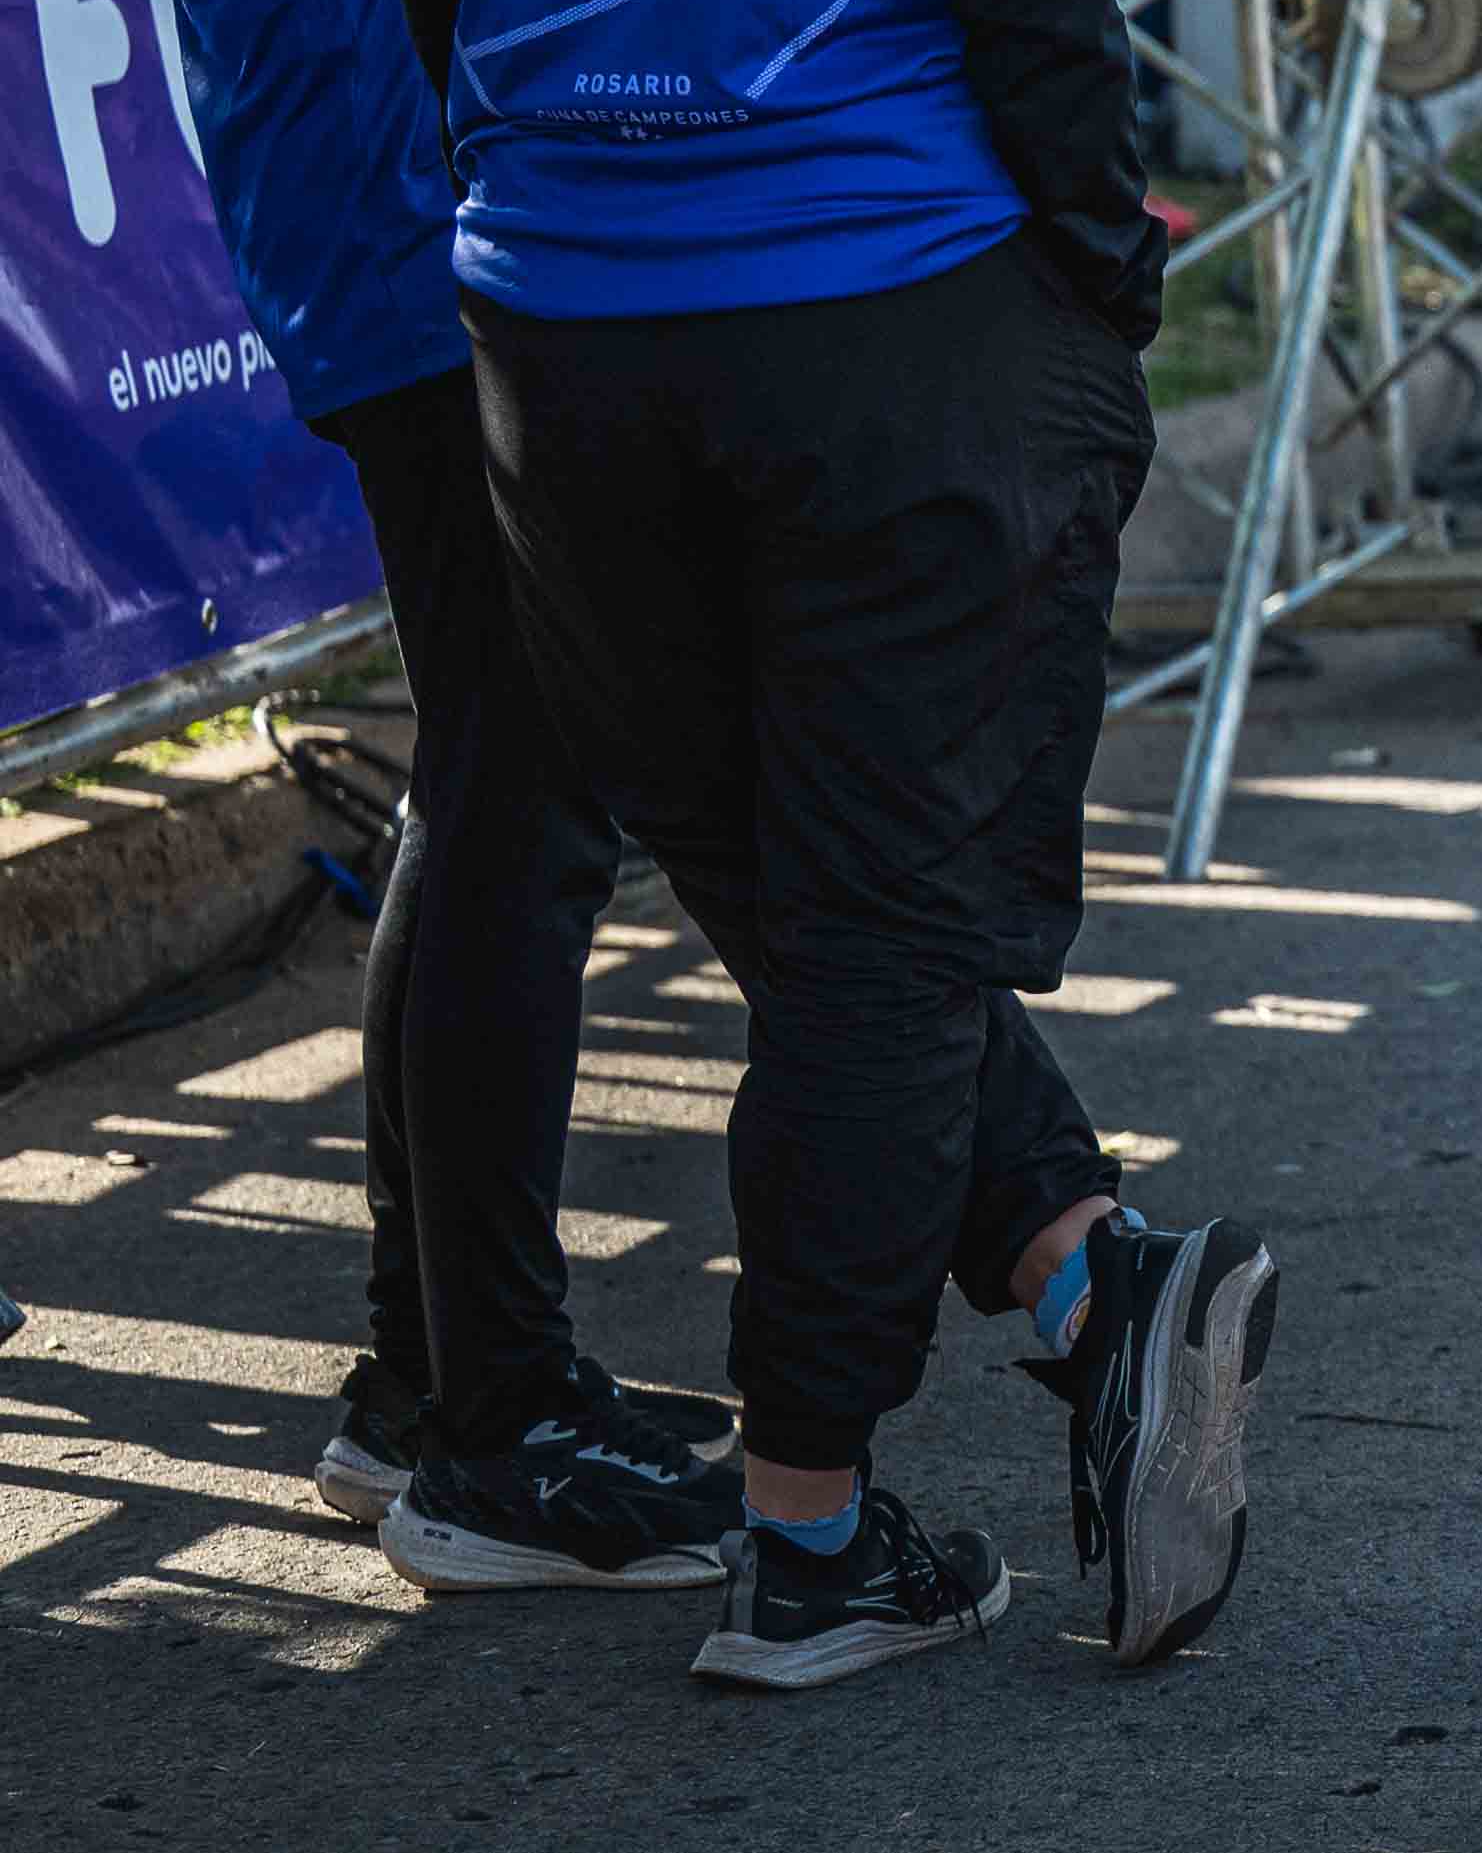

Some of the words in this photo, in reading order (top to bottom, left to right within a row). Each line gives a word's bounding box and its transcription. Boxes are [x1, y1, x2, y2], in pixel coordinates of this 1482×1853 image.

[574, 73, 692, 96] ROSARIO
[615, 108, 749, 125] CAMPEONES
[109, 349, 139, 412] el
[143, 338, 232, 403] nuevo
